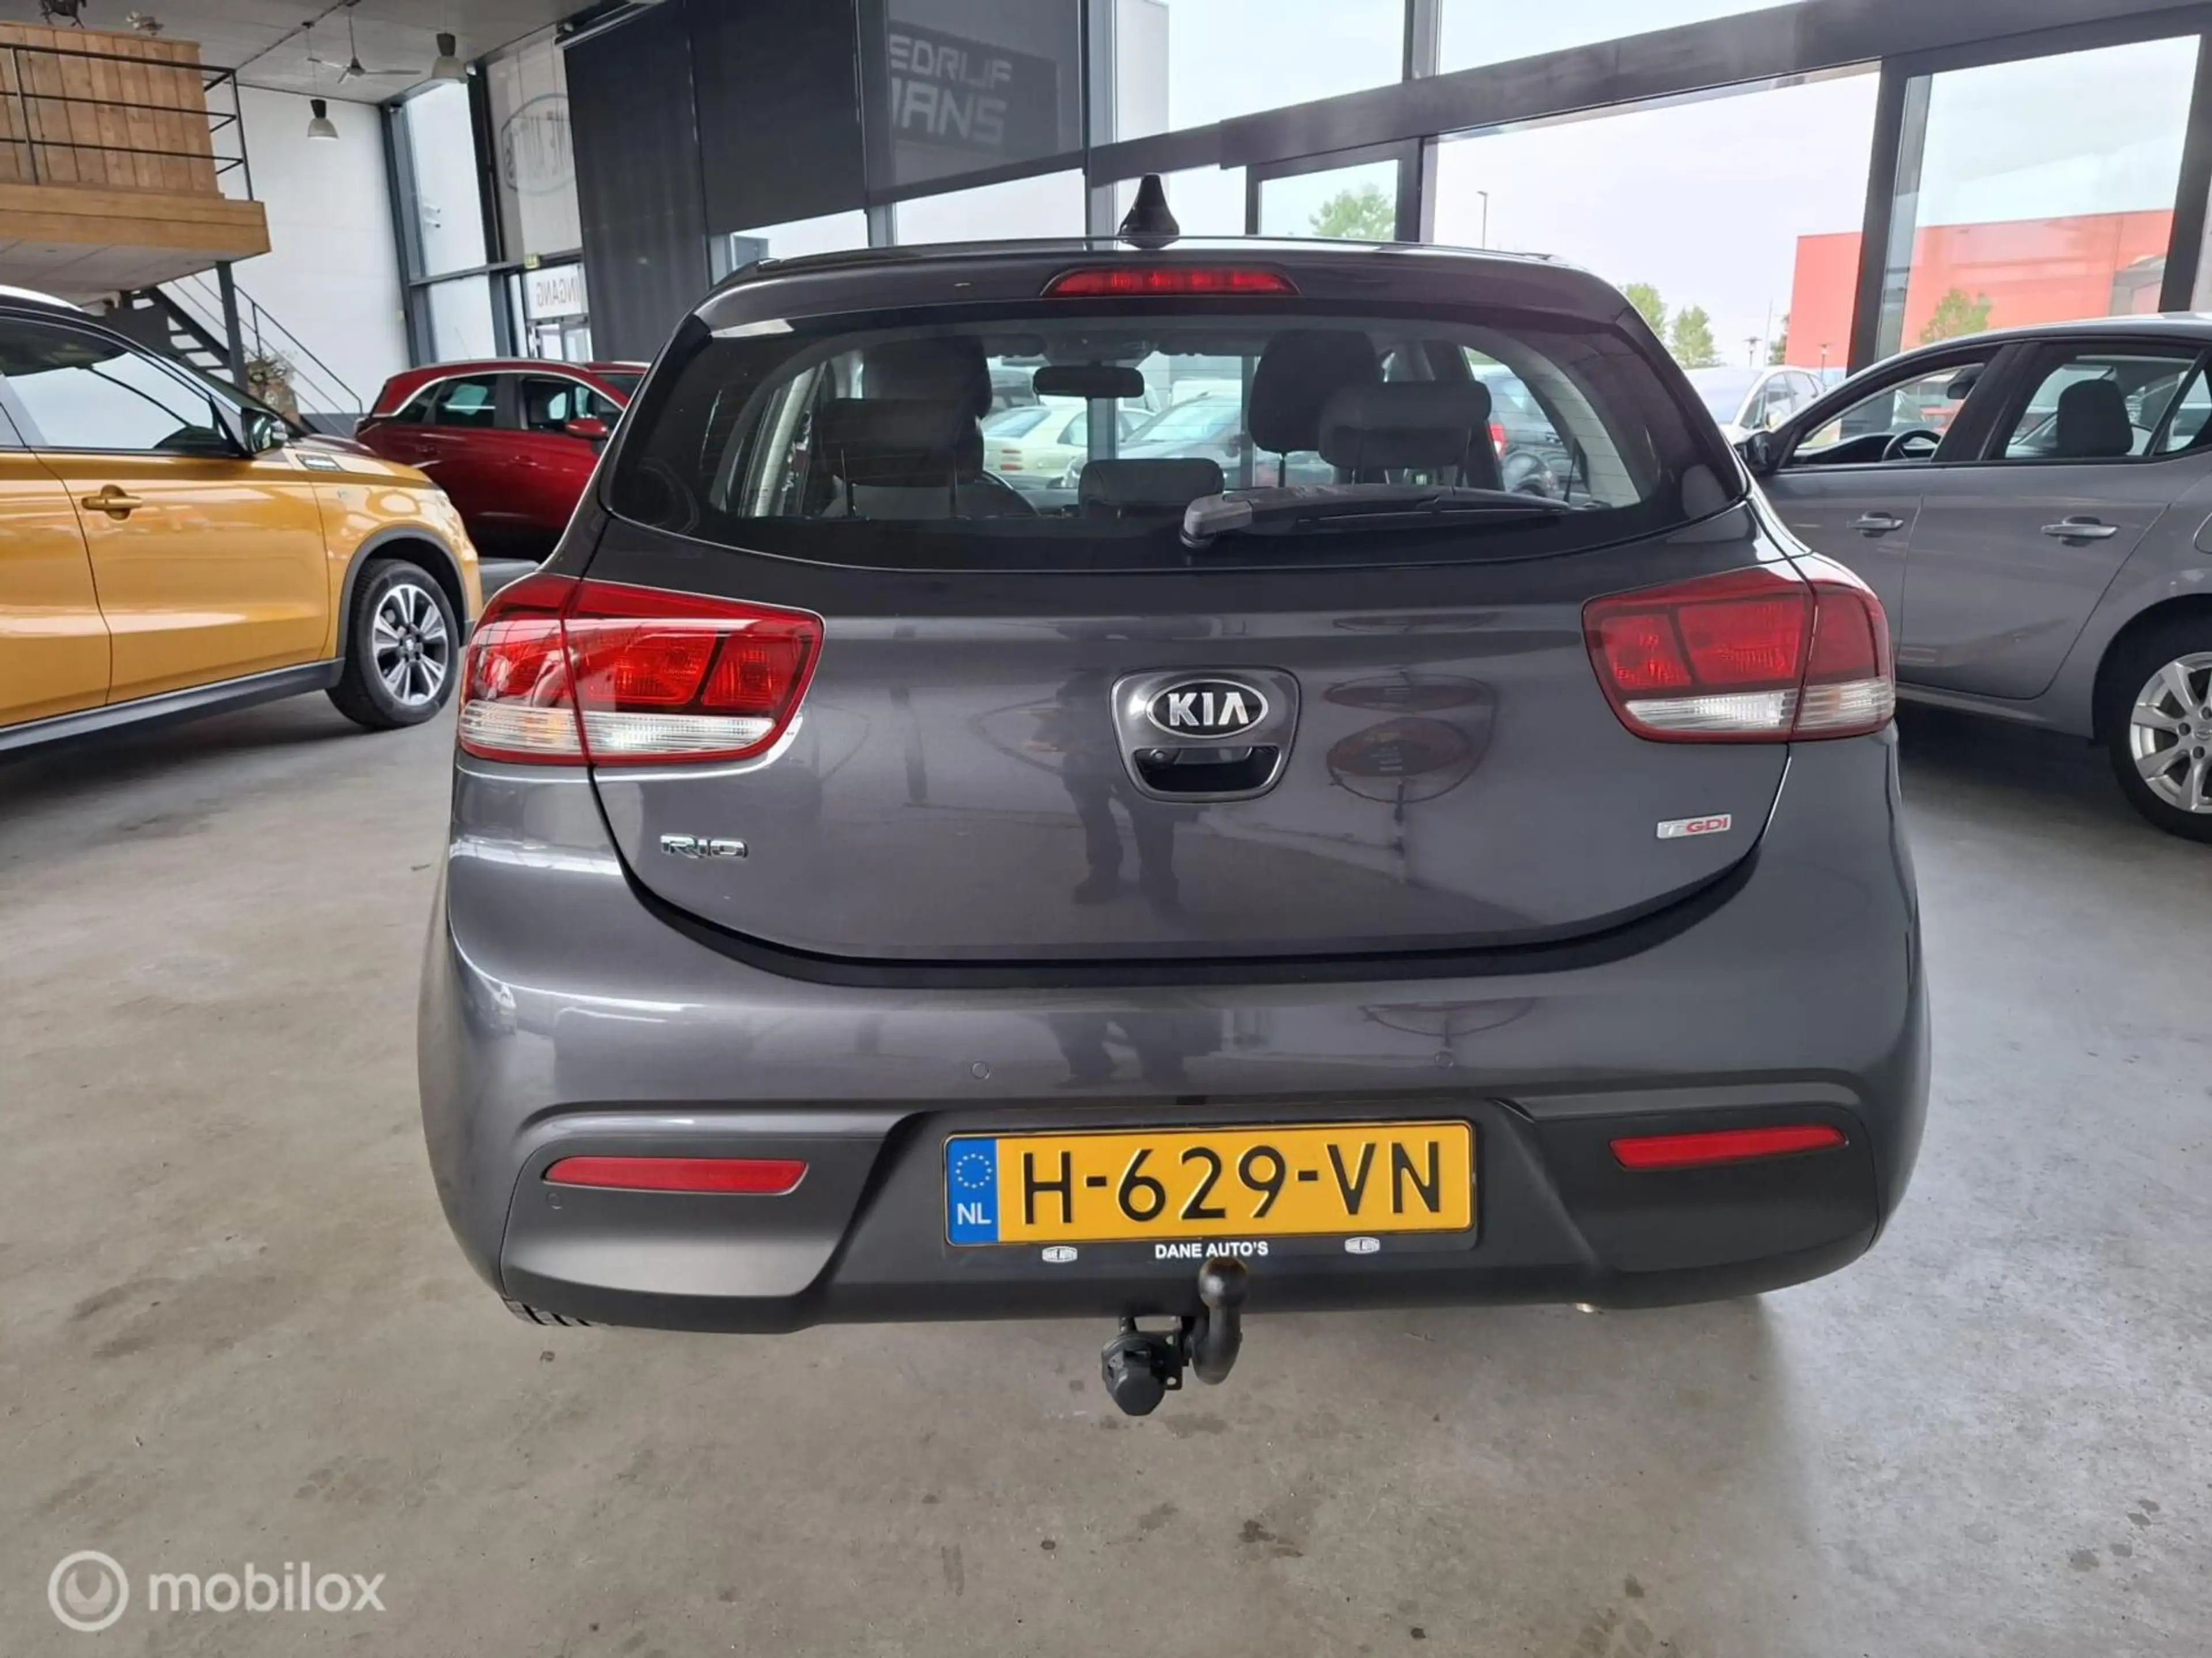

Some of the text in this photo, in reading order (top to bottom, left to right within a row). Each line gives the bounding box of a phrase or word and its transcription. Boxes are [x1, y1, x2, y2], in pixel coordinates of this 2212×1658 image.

[1168, 692, 1249, 726] KIA
[660, 834, 749, 859] RIO
[1022, 1140, 1441, 1226] H-629-VN
[957, 1202, 992, 1226] NL
[1155, 1241, 1269, 1259] DANE AUTO'S
